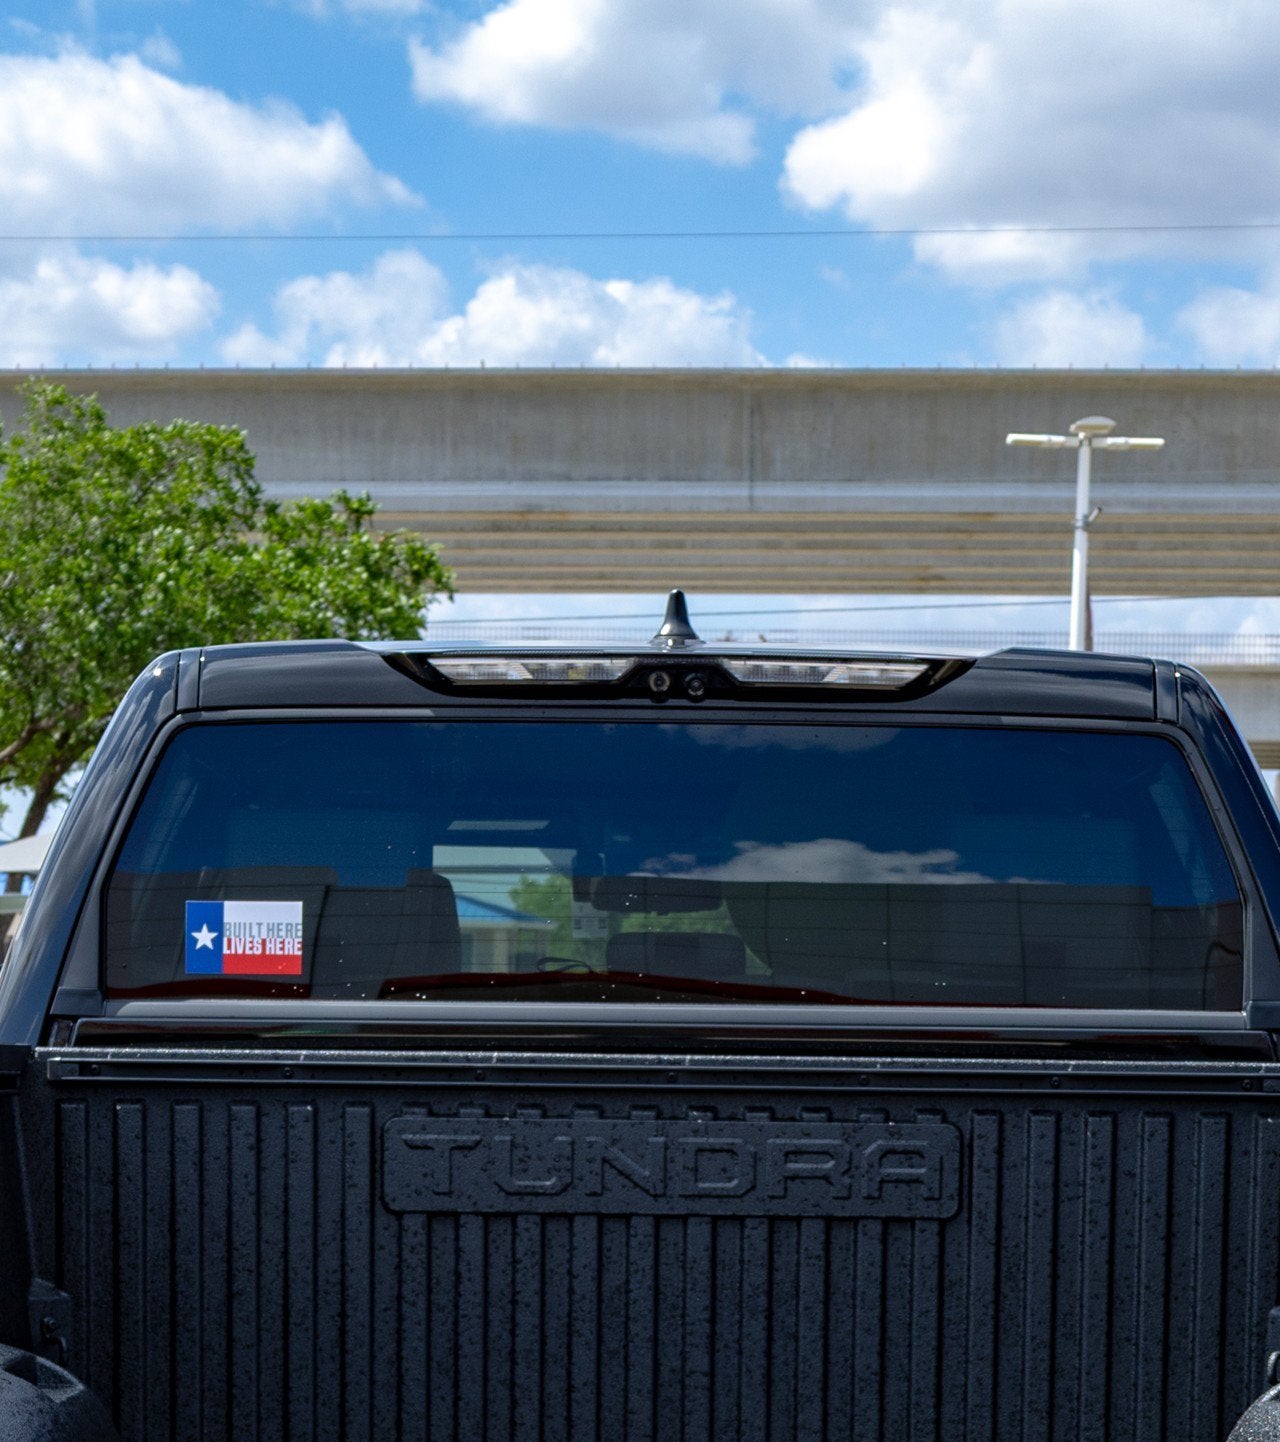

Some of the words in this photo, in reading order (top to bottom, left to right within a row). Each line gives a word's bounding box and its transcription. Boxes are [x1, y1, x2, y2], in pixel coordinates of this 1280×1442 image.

[224, 922, 264, 939] BUILT
[267, 922, 302, 939] HERE
[223, 938, 262, 955] LIVES
[265, 938, 302, 955] HERE
[400, 1134, 944, 1201] TUNDRA
